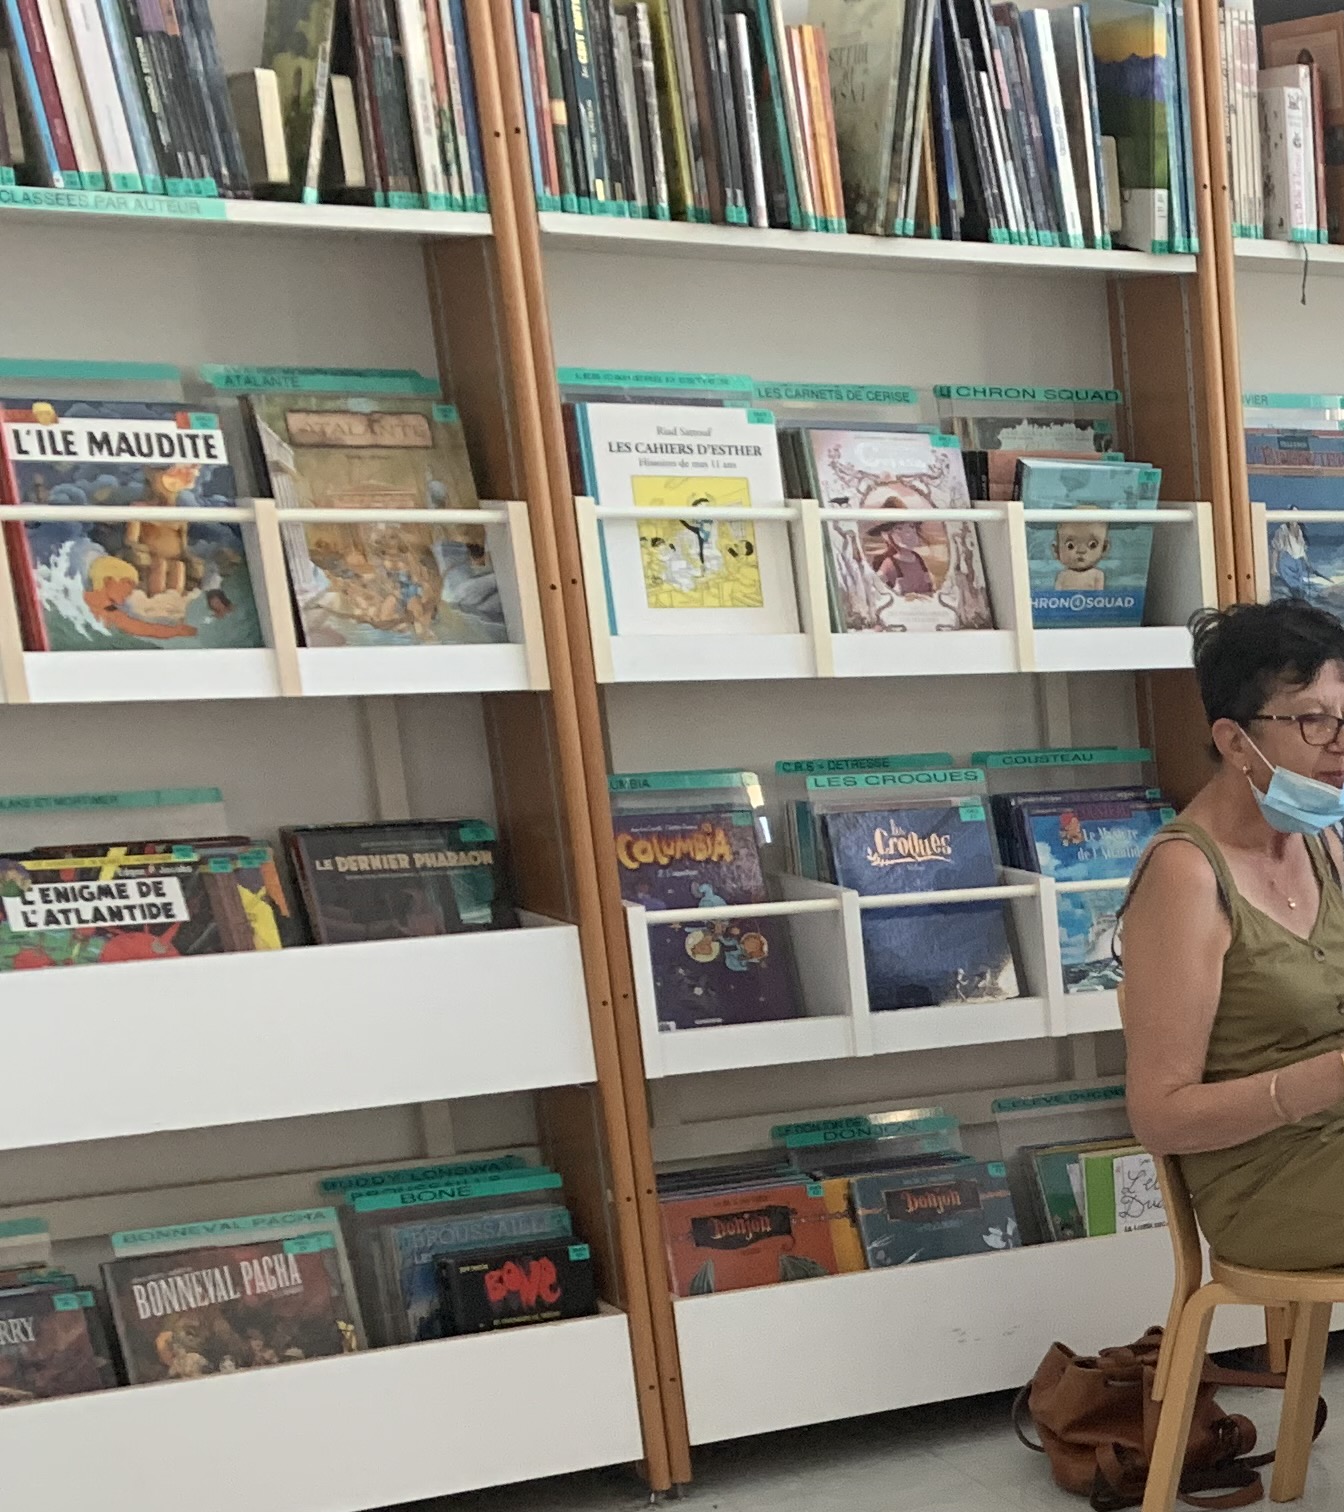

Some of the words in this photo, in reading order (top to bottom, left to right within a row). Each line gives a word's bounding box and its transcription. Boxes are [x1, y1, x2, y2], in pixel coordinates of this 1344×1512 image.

[94, 194, 131, 211] PAR
[132, 199, 201, 215] AUTEUR
[223, 373, 300, 389] ATALANTE
[757, 387, 781, 399] LES
[784, 388, 844, 401] CARNETS
[846, 389, 864, 401] DE
[867, 390, 911, 403] CERISE
[956, 385, 1037, 400] CHRON
[1043, 387, 1119, 402] SQUAD
[12, 427, 78, 456] L'ILE
[85, 430, 218, 459] MAUDITE
[608, 441, 632, 454] LES
[634, 442, 694, 456] CAHIERS
[696, 443, 763, 457] D'ESTHER
[1001, 752, 1094, 766] COUSTEAU
[813, 775, 858, 788] LES
[864, 770, 980, 787] CROQUES
[315, 859, 334, 871] LE
[334, 853, 410, 872] DERNIER
[412, 850, 495, 868] PHARAON
[136, 879, 167, 899] DE
[21, 901, 177, 928] L'ATLANTIDE
[822, 1118, 917, 1142] DONJON
[399, 1184, 473, 1205] BONE
[121, 1220, 242, 1244] BONNEVAL
[251, 1209, 328, 1229] PACHA
[131, 1263, 242, 1321] BONNEVAL
[238, 1252, 303, 1296] PACHA
